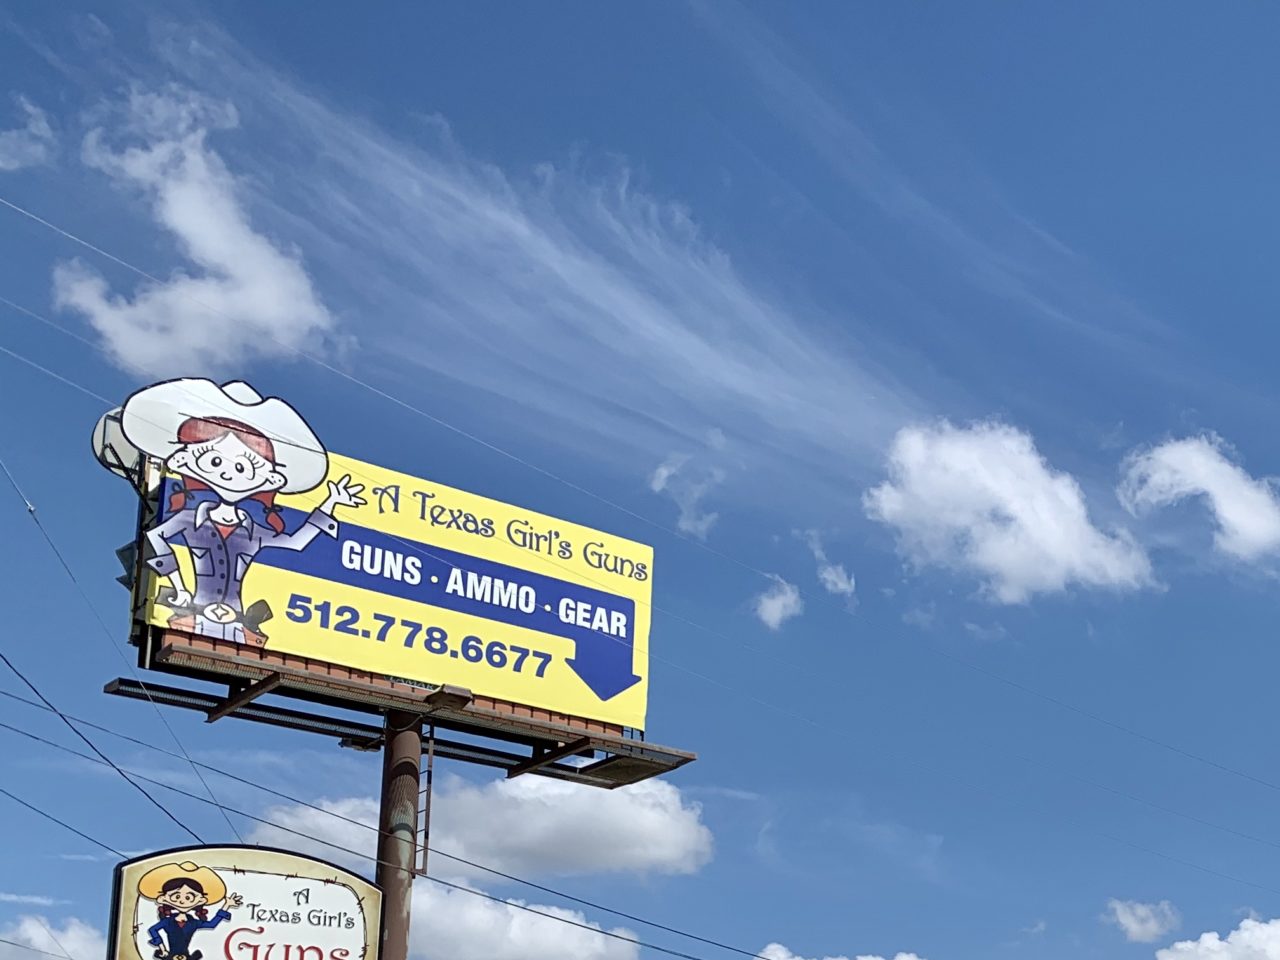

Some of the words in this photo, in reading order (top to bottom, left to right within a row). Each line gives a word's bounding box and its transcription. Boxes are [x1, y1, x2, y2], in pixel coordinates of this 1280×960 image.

[373, 485, 400, 513] A
[413, 490, 496, 538] Texas
[506, 519, 572, 559] Girl's
[583, 542, 648, 581] Guns
[341, 540, 422, 585] GUNS
[446, 568, 536, 614] AMMO
[559, 597, 627, 638] GEAR
[285, 593, 552, 679] 512.778.6677
[247, 903, 301, 923] Texas
[308, 909, 355, 929] Girl's
[293, 888, 310, 905] A
